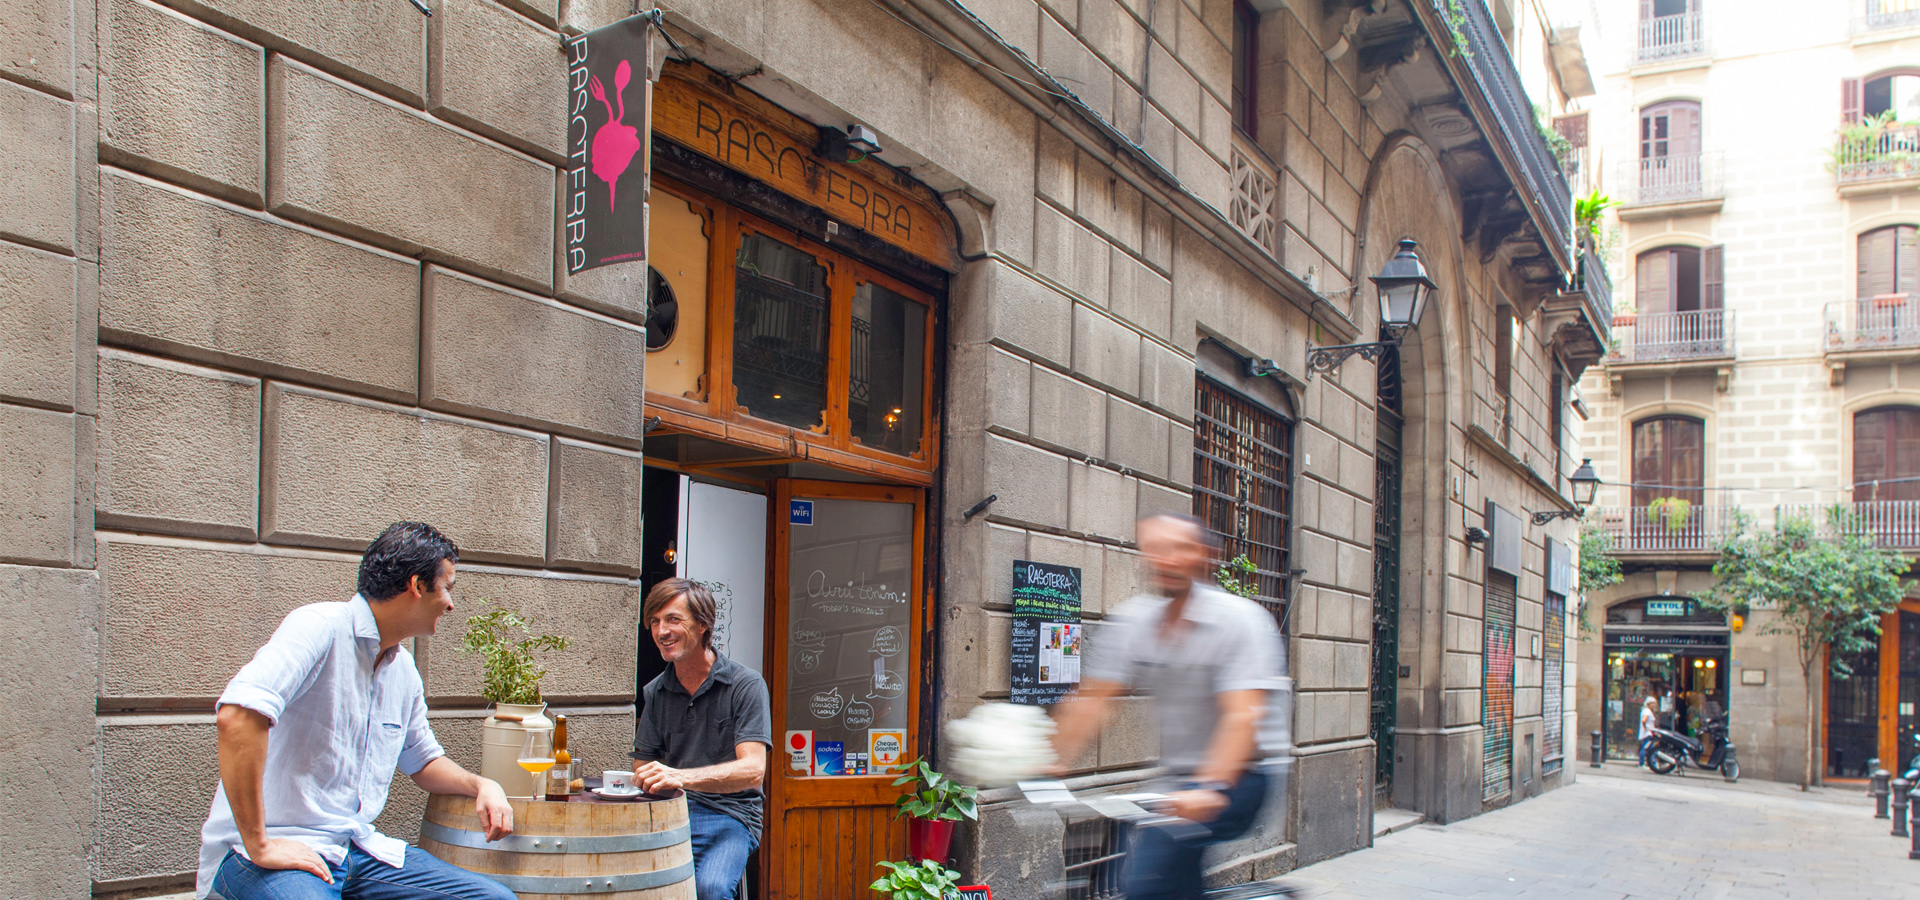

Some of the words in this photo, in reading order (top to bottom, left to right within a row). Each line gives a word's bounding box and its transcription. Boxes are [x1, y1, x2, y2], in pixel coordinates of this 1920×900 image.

[567, 36, 588, 272] RASOTERRA
[696, 99, 912, 242] RASOTERRA
[792, 508, 810, 517] WiFi
[1028, 564, 1072, 592] RASOTERRA
[817, 745, 842, 753] sodexo
